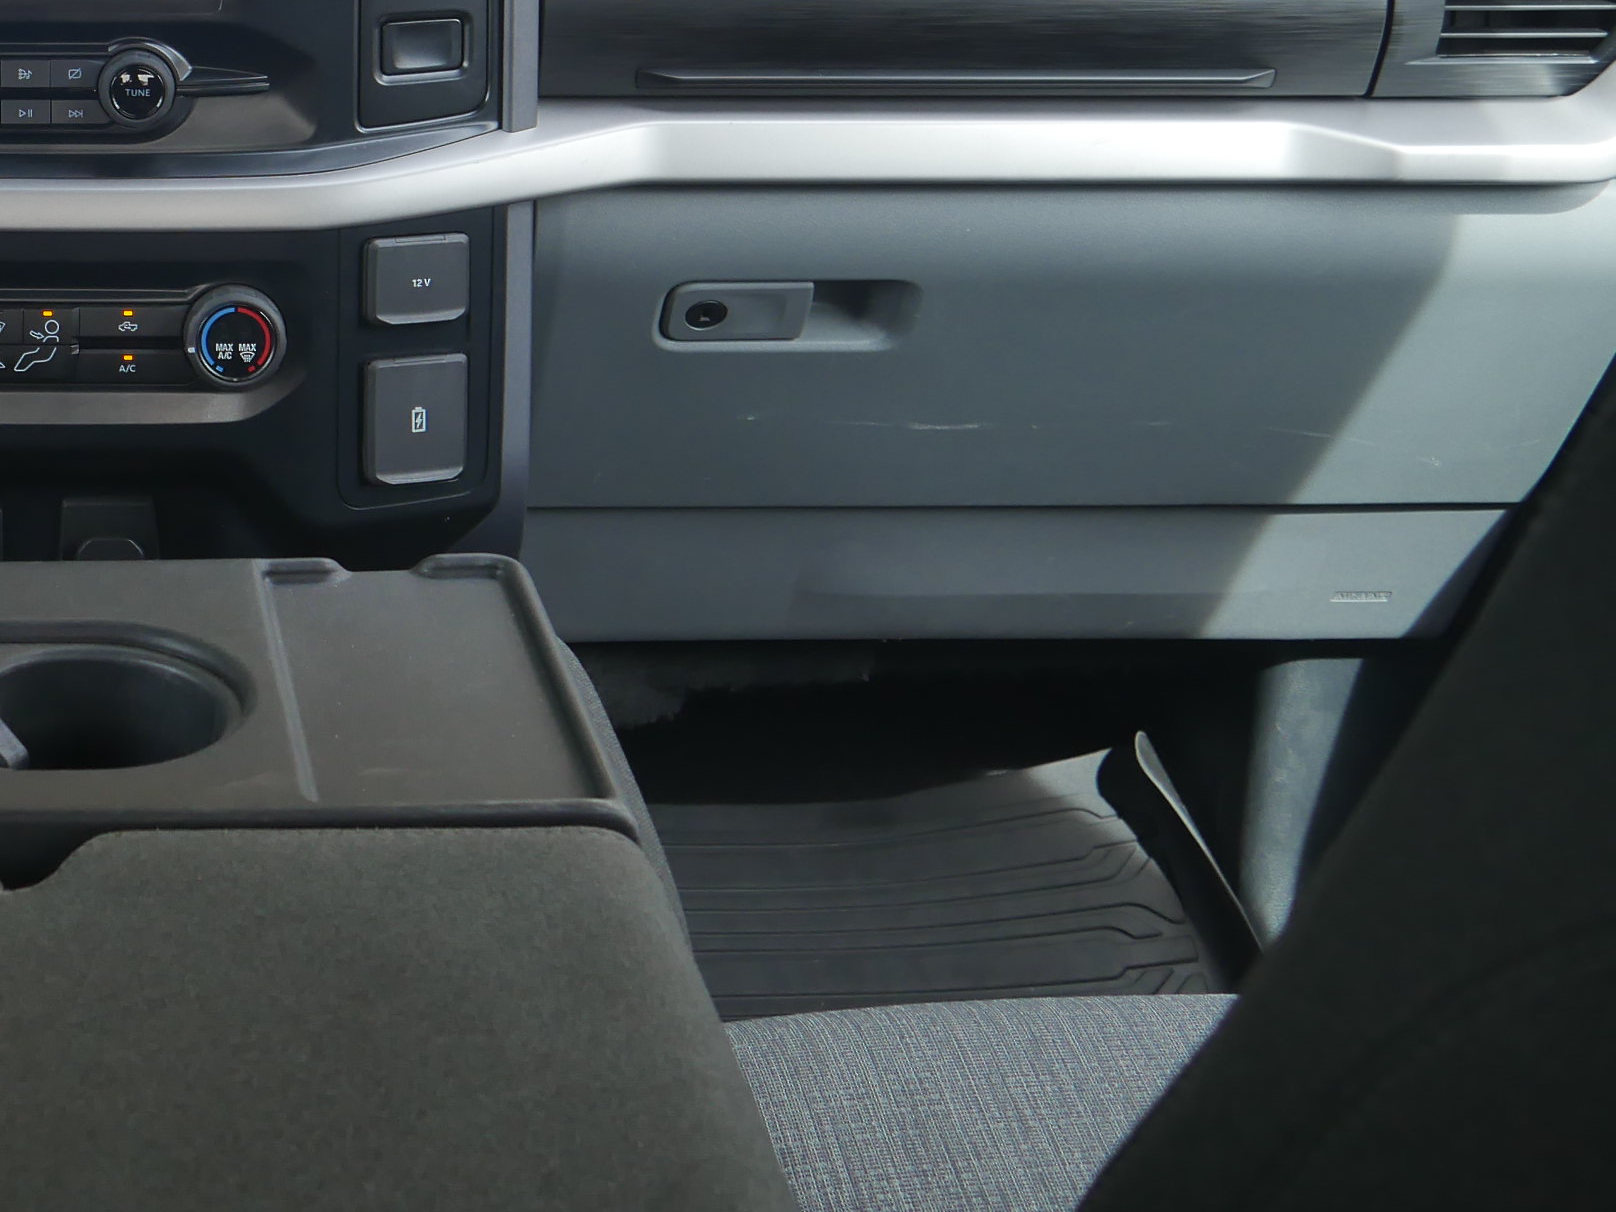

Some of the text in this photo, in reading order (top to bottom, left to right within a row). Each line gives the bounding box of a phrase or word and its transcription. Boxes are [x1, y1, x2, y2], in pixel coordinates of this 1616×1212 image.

[125, 88, 151, 97] TUNE
[215, 343, 234, 352] MAX
[238, 343, 257, 352] MAX
[217, 351, 233, 360] A/C
[119, 365, 136, 373] A/C
